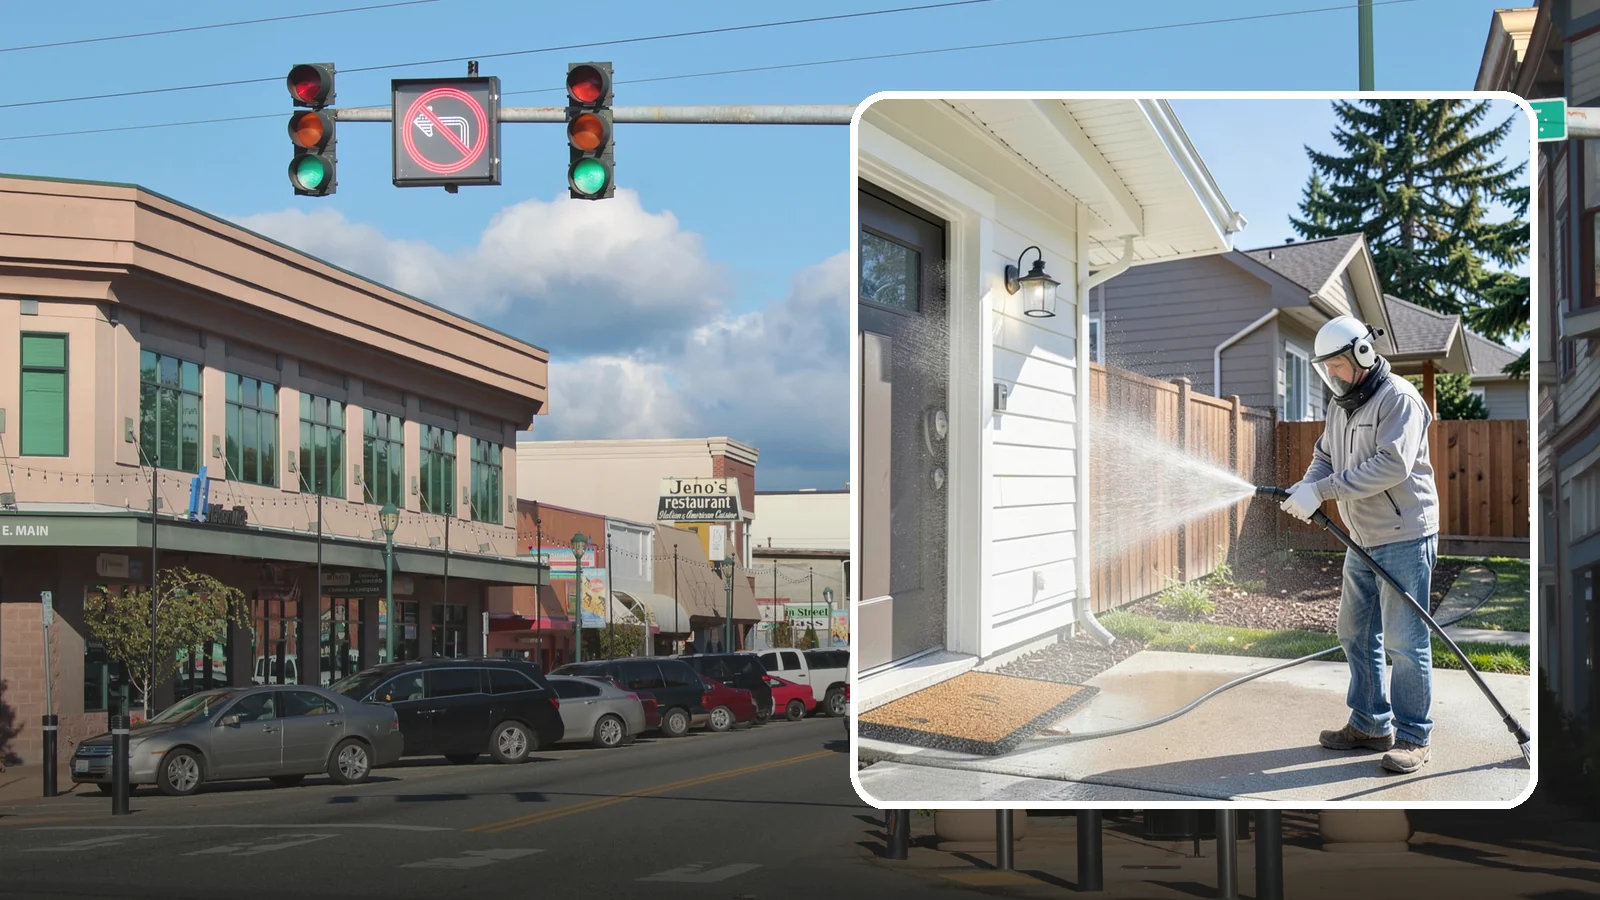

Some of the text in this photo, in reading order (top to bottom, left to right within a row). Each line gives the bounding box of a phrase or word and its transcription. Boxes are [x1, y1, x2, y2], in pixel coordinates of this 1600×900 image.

[669, 480, 727, 495] Jeno's
[665, 496, 731, 509] restaurant
[659, 510, 681, 520] Italian
[686, 509, 714, 519] American
[715, 509, 738, 519] Cuisine
[2, 525, 49, 536] E. MAIN
[797, 607, 828, 617] Street
